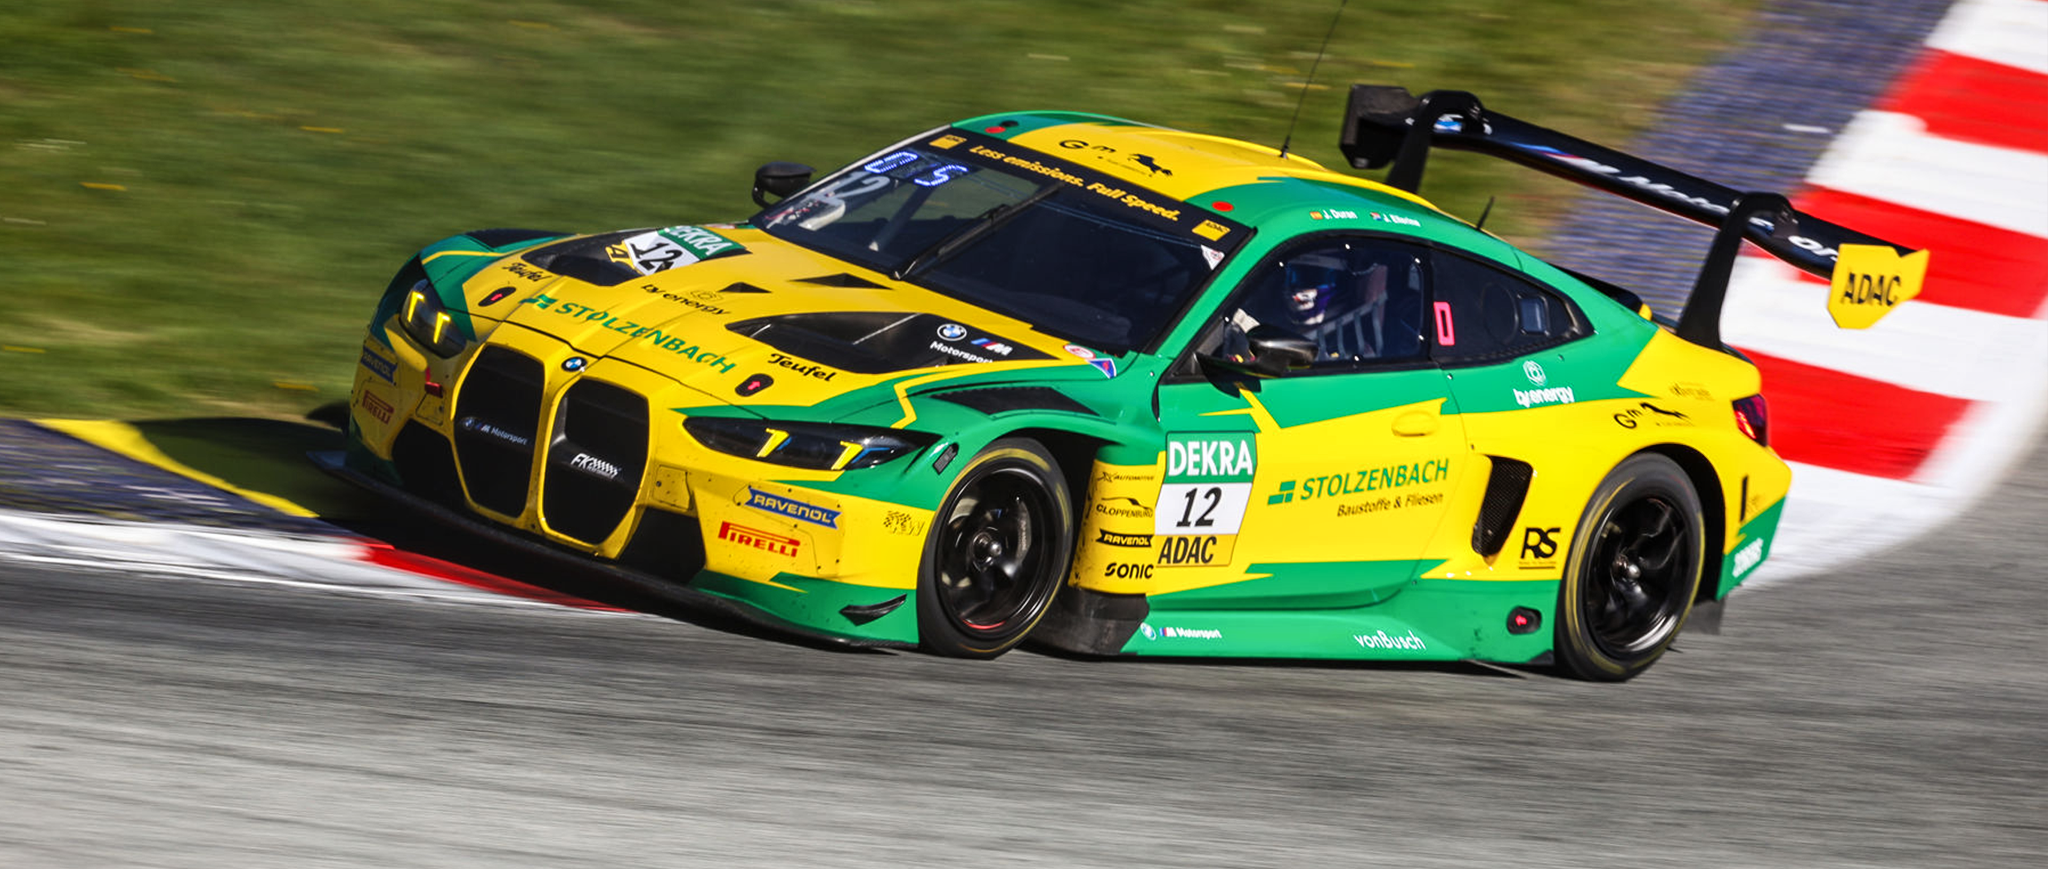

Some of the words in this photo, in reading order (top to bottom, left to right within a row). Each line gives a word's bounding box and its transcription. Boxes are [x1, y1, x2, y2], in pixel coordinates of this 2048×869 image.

[969, 145, 1004, 161] Less
[1003, 154, 1084, 187] emissions.
[1086, 182, 1127, 200] Full
[1121, 193, 1183, 222] Speed.
[630, 242, 684, 271] 12
[1840, 271, 1902, 308] ADAC
[554, 301, 737, 374] STOLZENBACH
[767, 352, 837, 382] Teufel
[1168, 439, 1253, 477] DEKRA
[1299, 458, 1449, 501] STOLZENBACH
[753, 493, 833, 525] RAVENOL
[1176, 486, 1222, 528] 12
[1336, 497, 1392, 518] Baustoffe
[1393, 498, 1402, 509] &
[1404, 492, 1444, 508] Fliesen
[718, 521, 801, 558] PIRELLI
[1103, 533, 1150, 546] RAVENOL
[1157, 535, 1217, 565] ADAC
[1520, 527, 1561, 559] RS
[1353, 629, 1427, 651] vonBusch
